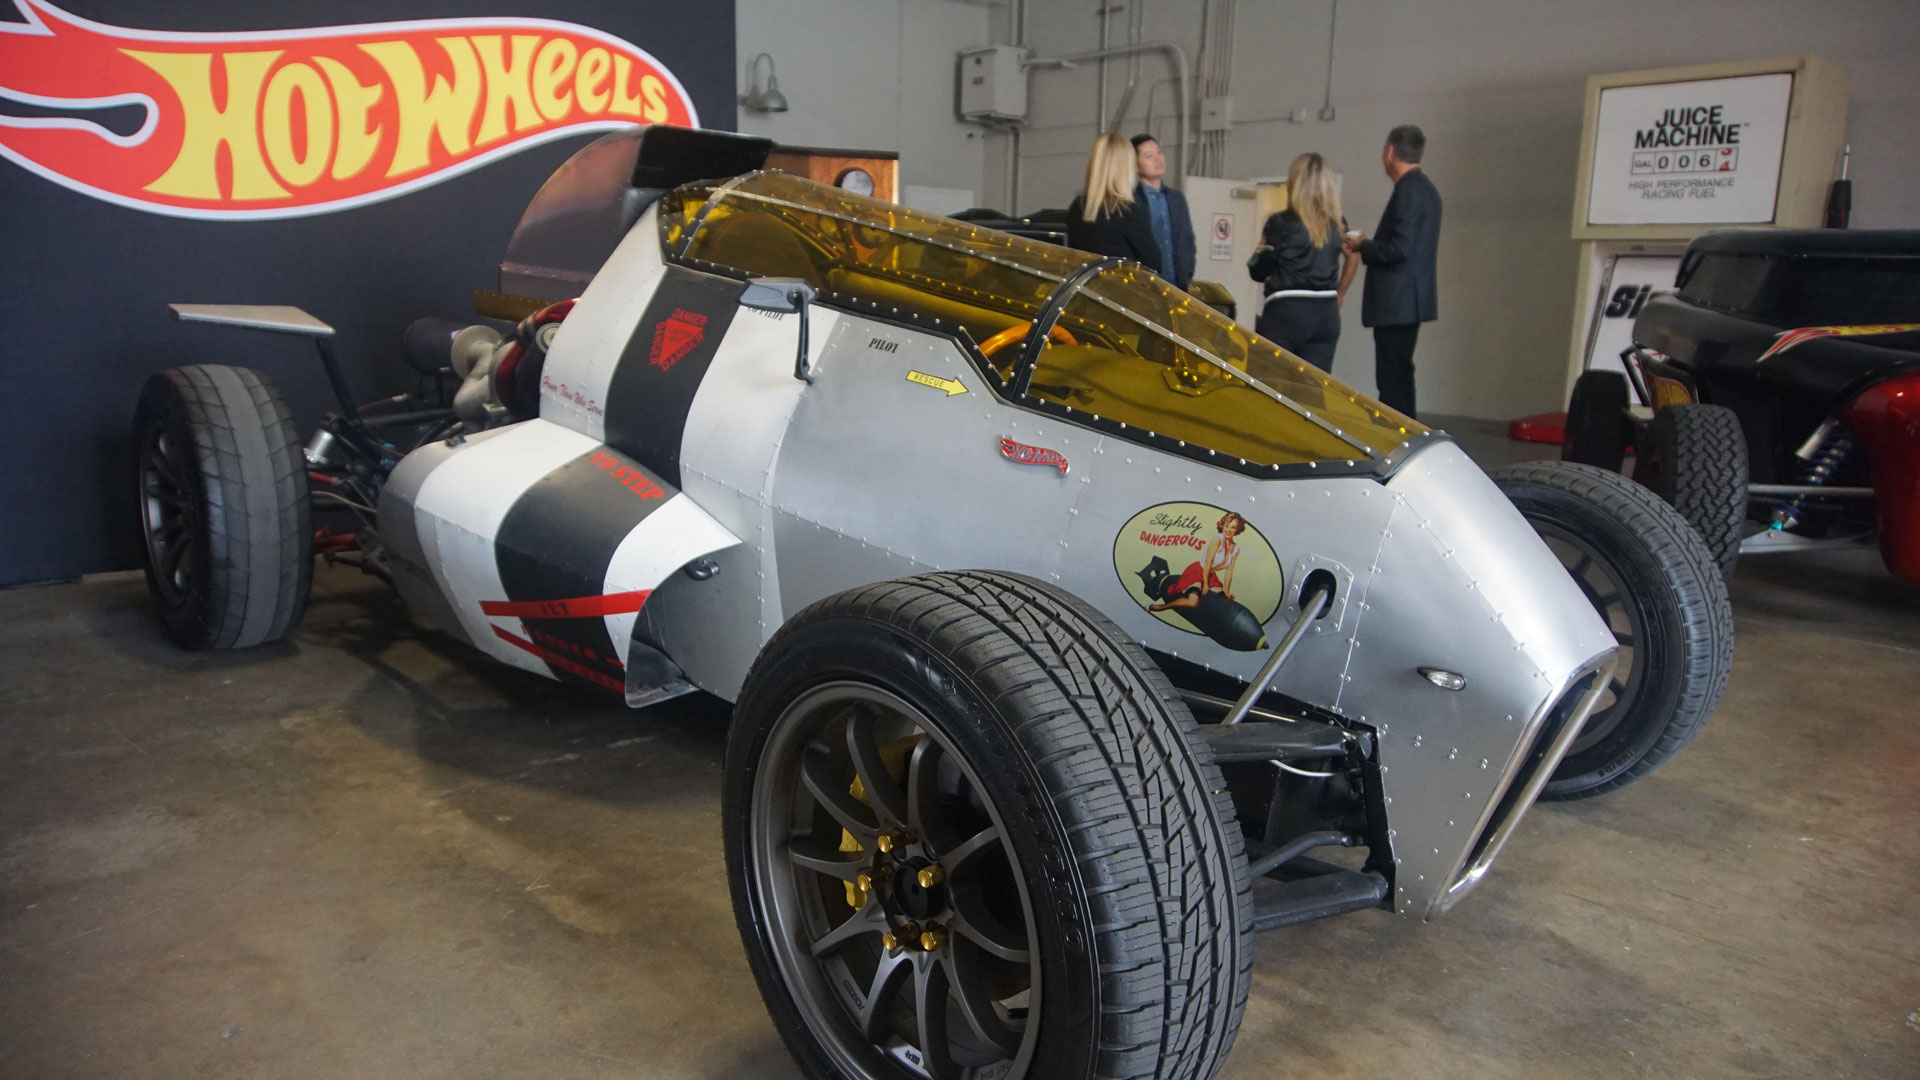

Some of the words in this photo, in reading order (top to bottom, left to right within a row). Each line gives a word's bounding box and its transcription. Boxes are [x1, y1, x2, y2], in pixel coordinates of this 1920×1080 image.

[1655, 105, 1724, 128] JUICE
[1634, 123, 1741, 149] MACHINE
[1635, 160, 1652, 168] GAL
[1628, 180, 1653, 190] HIGH
[1657, 177, 1735, 189] PERFORMANCE
[1641, 189, 1684, 200] RACING
[1689, 187, 1716, 199] FUEL
[662, 332, 704, 372] DANGER
[868, 337, 899, 354] PILOT
[913, 373, 945, 388] RESCUE
[585, 451, 619, 470] NO
[609, 465, 665, 500] STEP
[1150, 513, 1202, 535] Slightly
[1139, 530, 1207, 551] DANGEROUS
